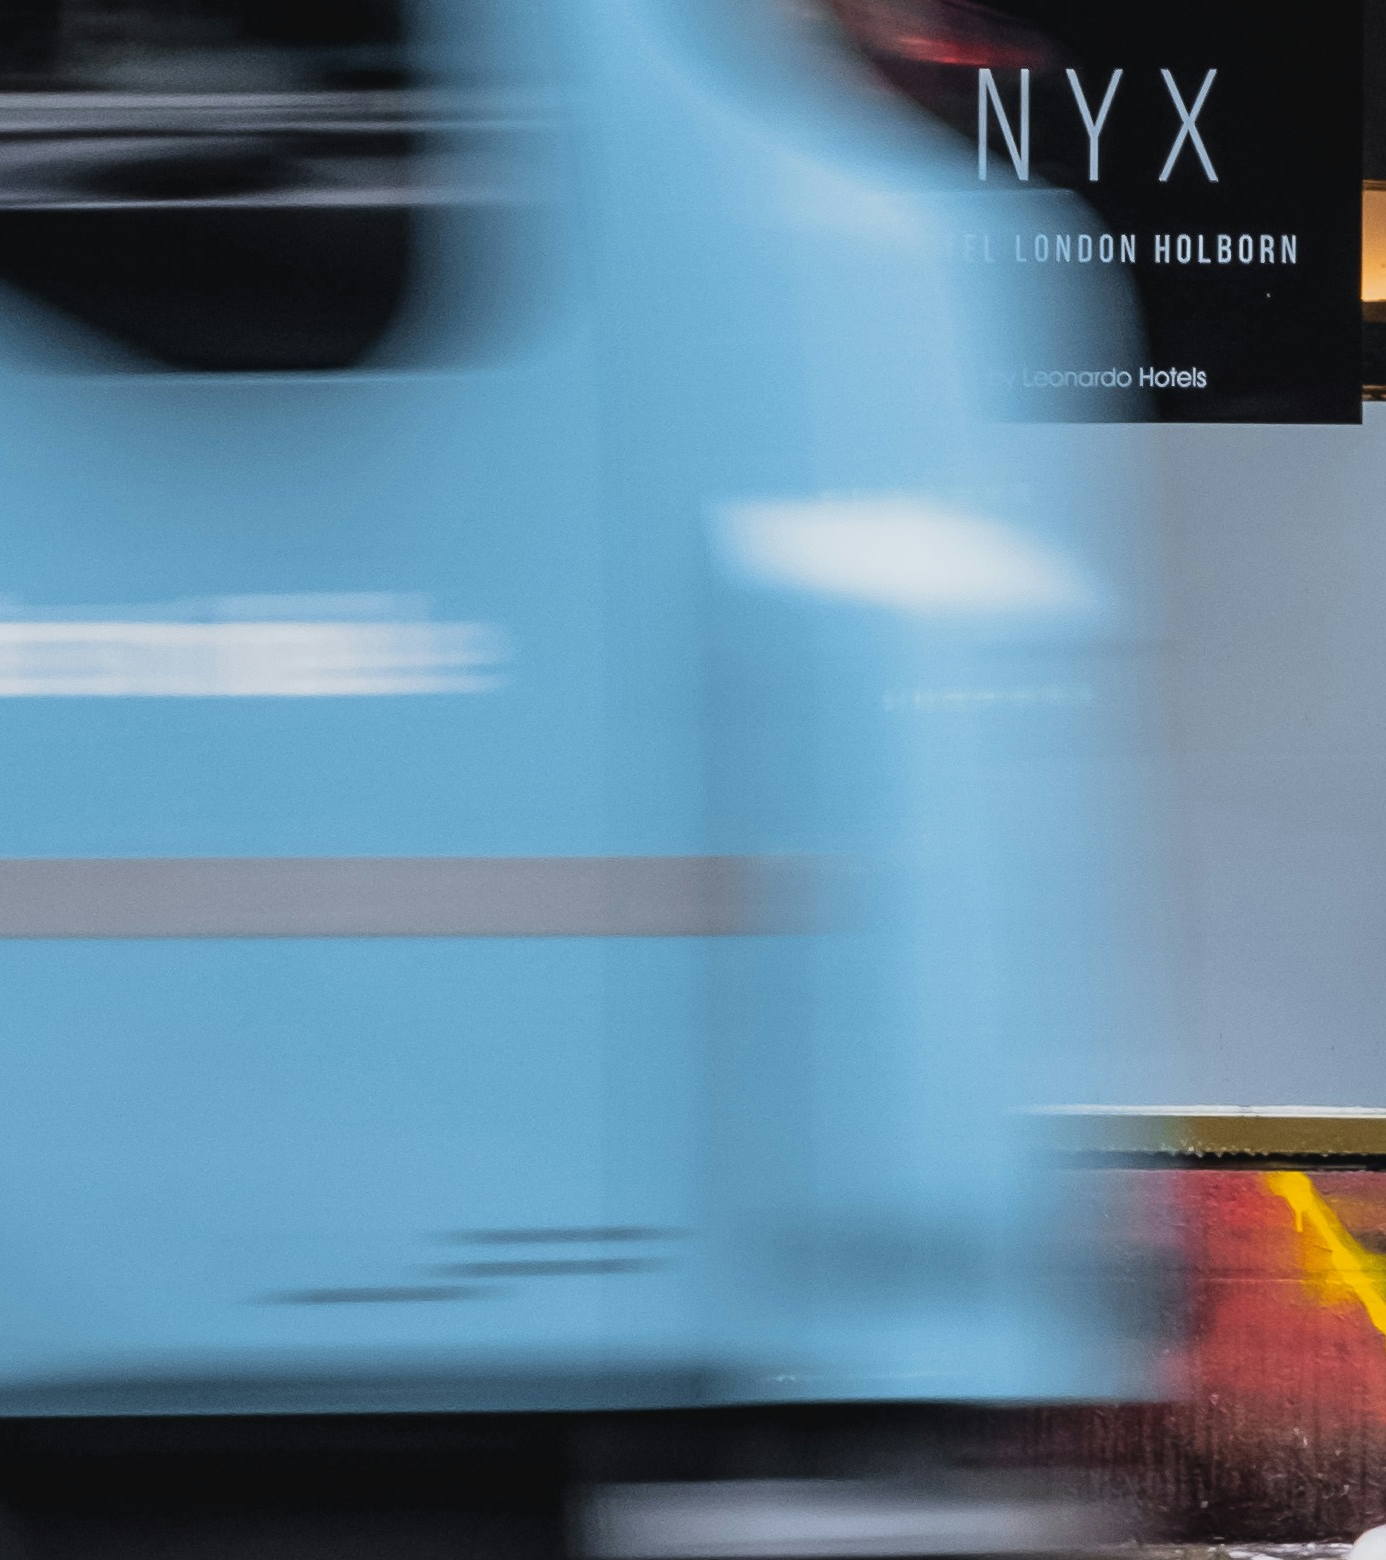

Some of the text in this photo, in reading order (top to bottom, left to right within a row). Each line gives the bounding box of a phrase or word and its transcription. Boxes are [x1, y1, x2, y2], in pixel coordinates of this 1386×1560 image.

[978, 68, 1218, 182] NYX
[1015, 234, 1138, 264] LONDON
[1154, 234, 1298, 264] HOLBORN
[1139, 366, 1208, 389] Hotels
